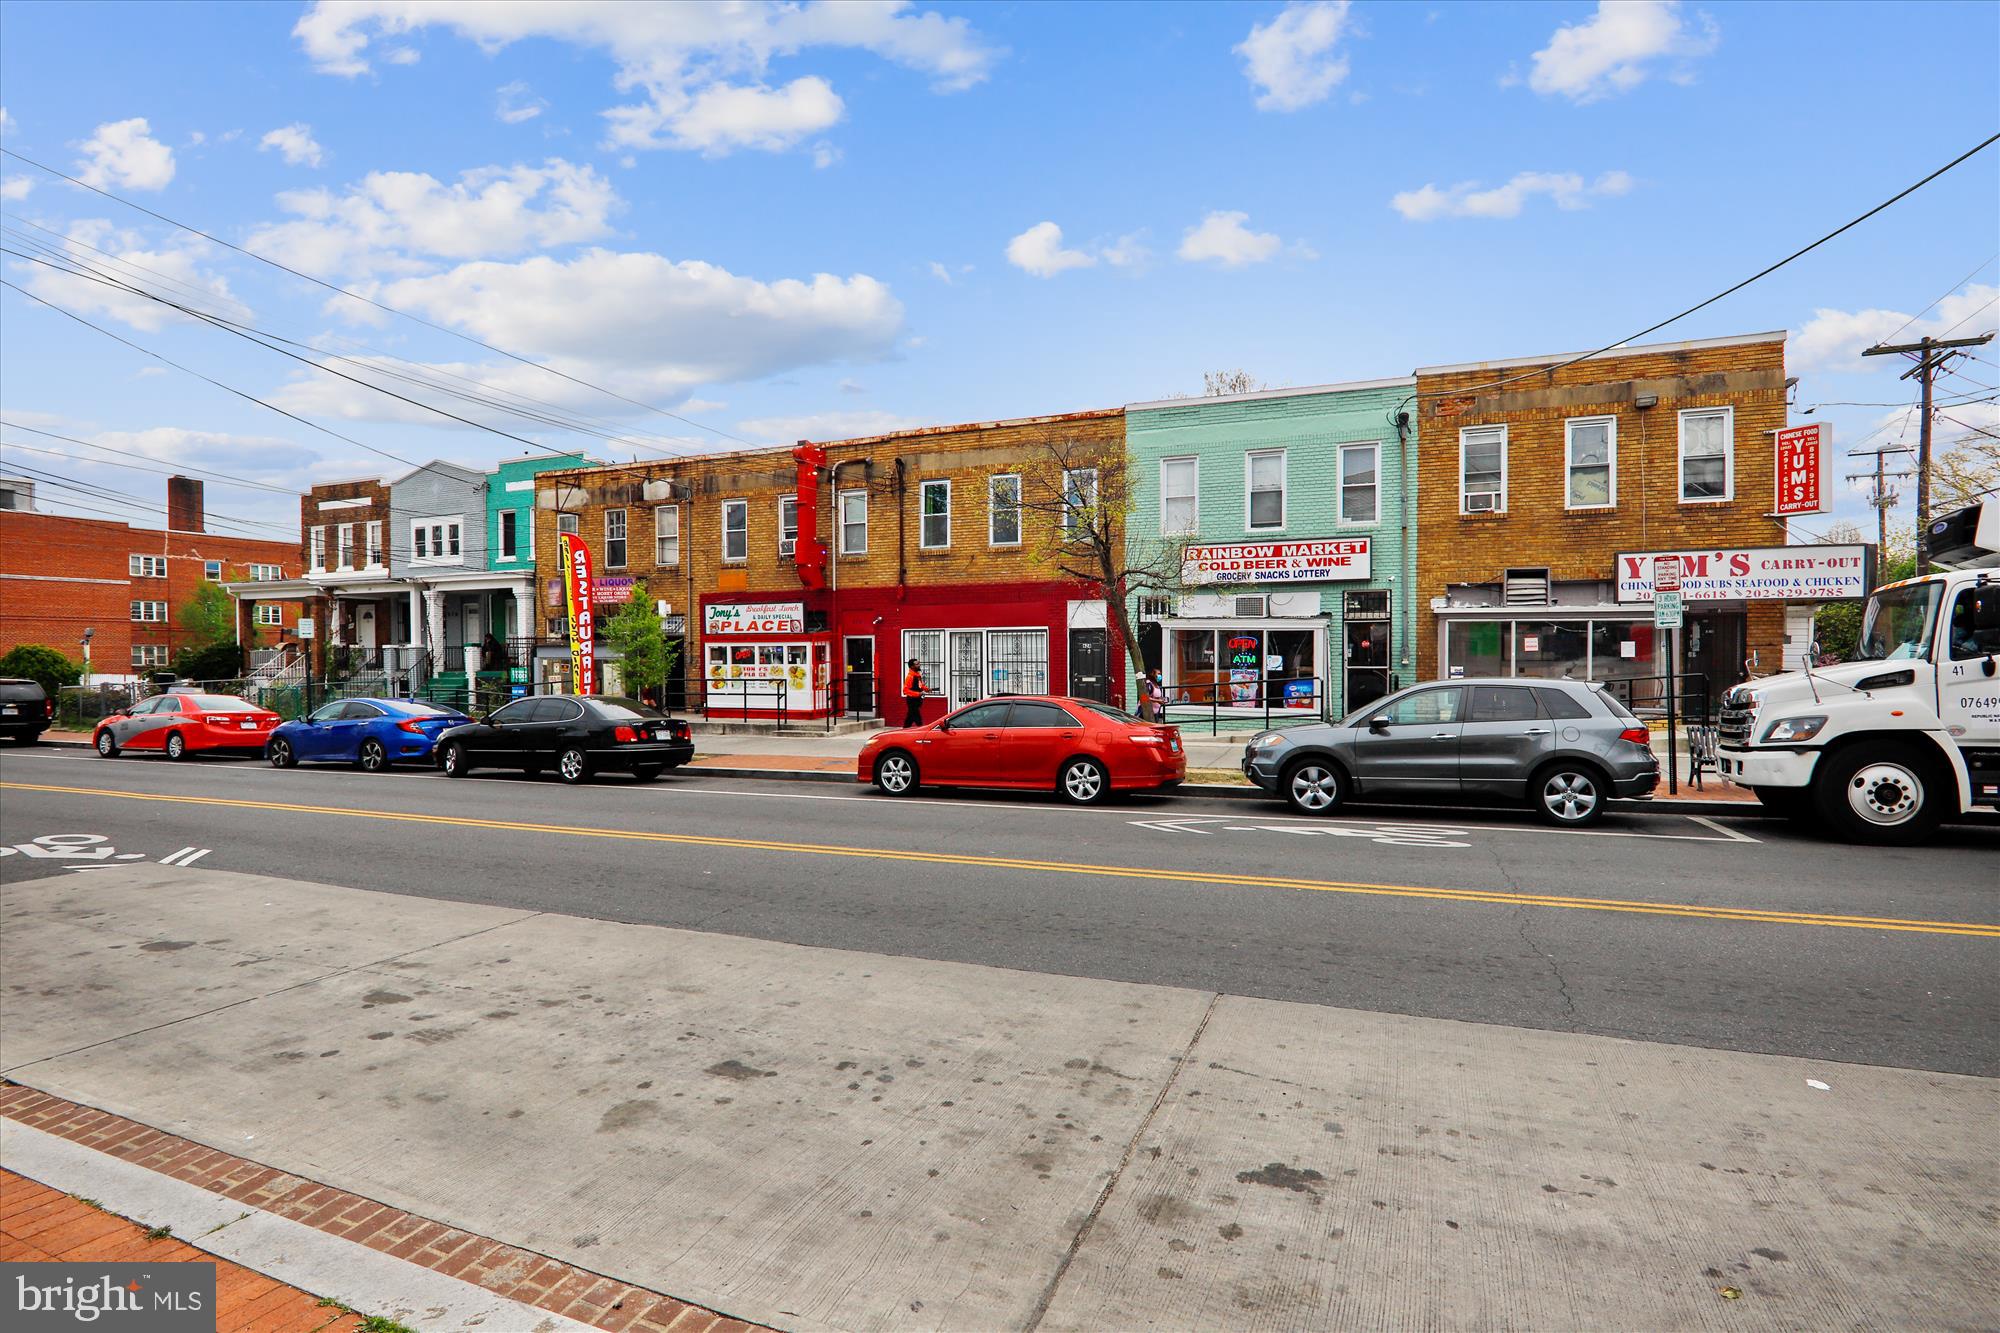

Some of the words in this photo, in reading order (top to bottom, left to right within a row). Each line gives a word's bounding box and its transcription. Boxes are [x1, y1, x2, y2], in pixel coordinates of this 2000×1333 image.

[1780, 430, 1802, 440] CHINESE
[1804, 428, 1818, 436] FOOD
[1791, 438, 1806, 500] YUMS
[1780, 500, 1818, 510] CARRY-OUT
[1186, 546, 1275, 560] RAINBOW
[1282, 542, 1364, 556] MARKET
[1199, 562, 1240, 571] COLD
[1244, 560, 1287, 569] BEER
[1292, 559, 1302, 568] &
[1306, 557, 1352, 567] WINE
[1624, 552, 1750, 579] YM'S
[1761, 558, 1860, 570] CARRY-OUT
[1216, 572, 1252, 580] GROCERY
[1255, 570, 1290, 580] SNACKS
[1294, 568, 1330, 578] LOTTERY
[1704, 579, 1732, 588] SUBS
[1735, 578, 1788, 588] SEAFOOD
[1806, 576, 1860, 586] CHICKEN
[1746, 588, 1844, 598] 202-829-9785
[709, 606, 740, 620] Tony's
[746, 604, 776, 614] Breakfast
[720, 620, 789, 632] PLACE
[1229, 638, 1256, 648] OPEN
[1232, 655, 1256, 663] ATM
[1952, 666, 1964, 676] 41
[1961, 698, 2000, 708] 07649
